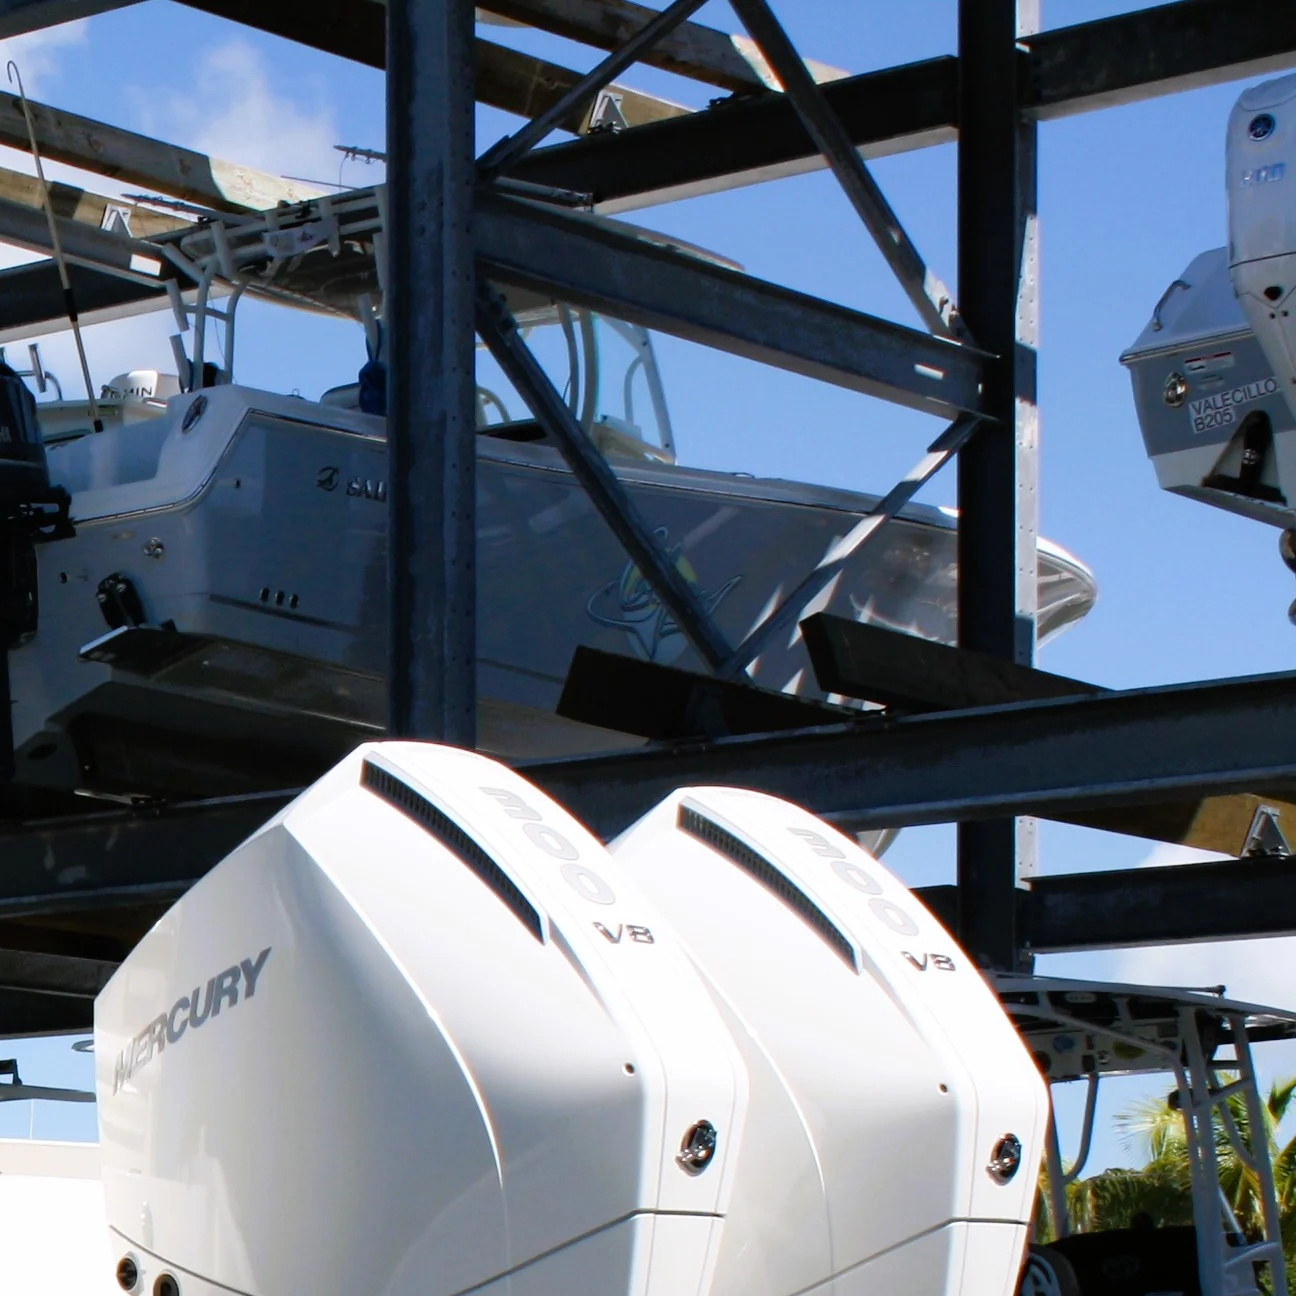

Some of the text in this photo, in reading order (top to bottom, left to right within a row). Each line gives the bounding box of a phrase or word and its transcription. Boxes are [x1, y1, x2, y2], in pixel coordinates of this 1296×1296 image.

[1194, 408, 1234, 432] B205
[592, 921, 656, 945] V8
[900, 950, 957, 972] V8
[113, 946, 273, 1097] MERCURY
